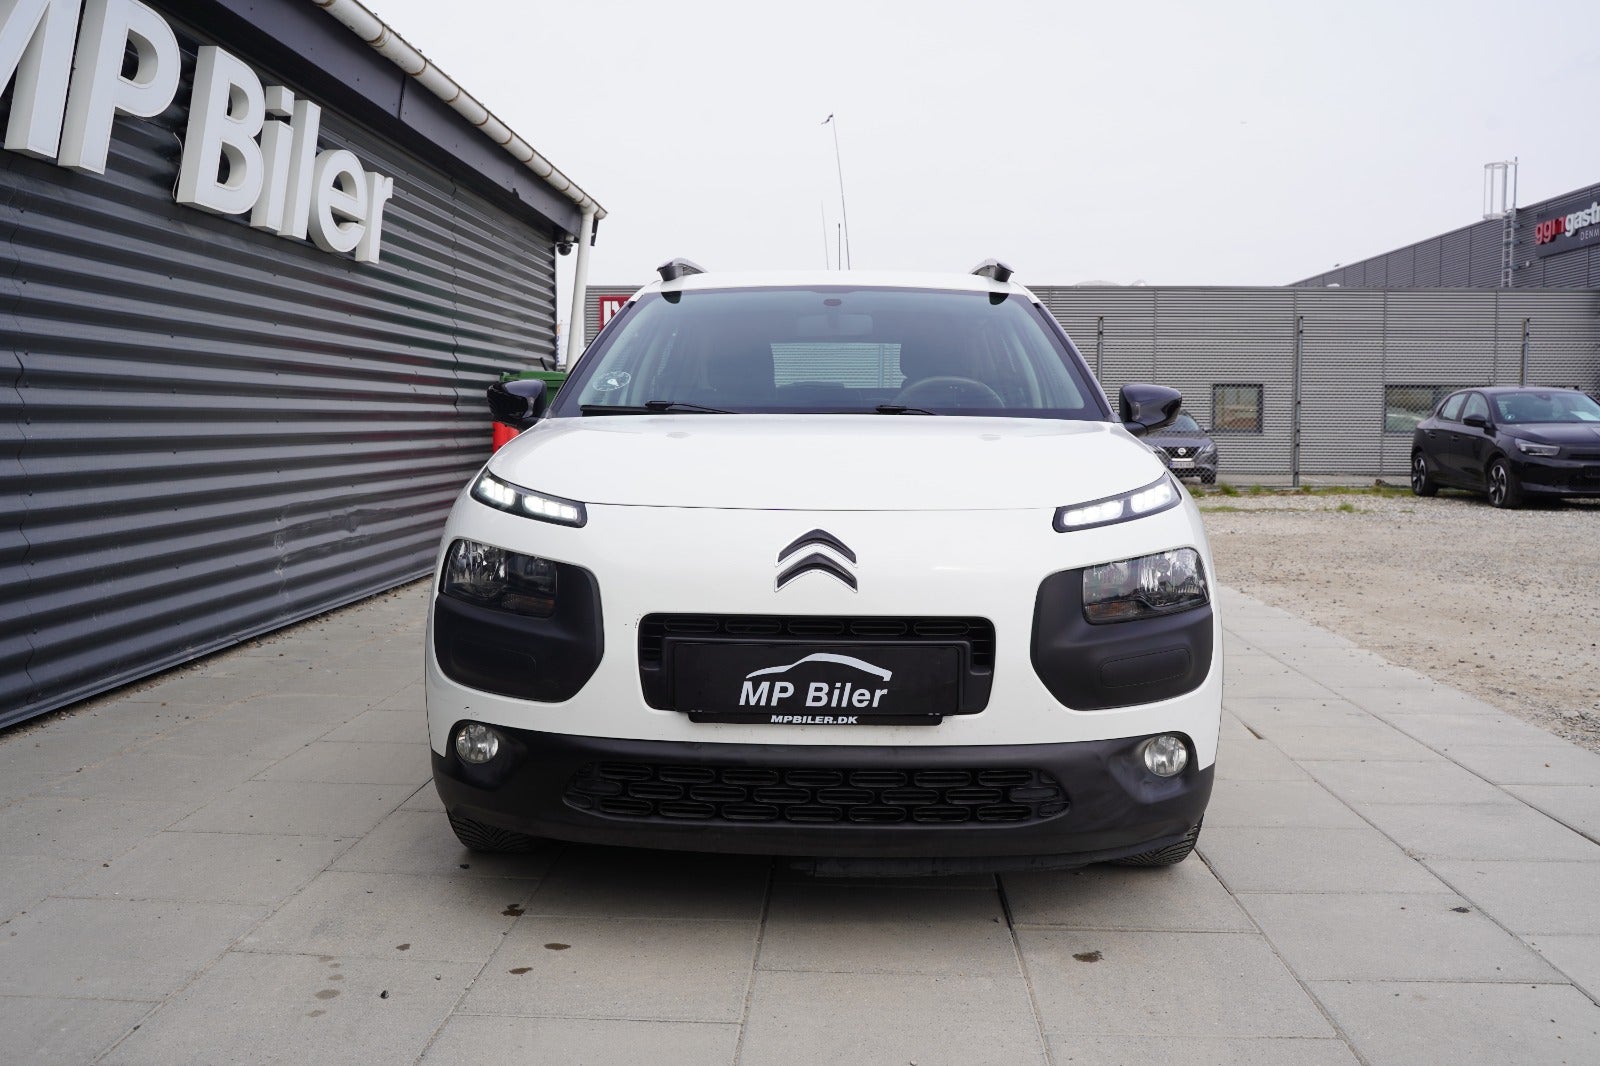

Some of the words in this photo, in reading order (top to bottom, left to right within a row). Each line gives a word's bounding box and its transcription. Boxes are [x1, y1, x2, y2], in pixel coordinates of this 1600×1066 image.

[176, 45, 394, 265] Biler
[738, 681, 794, 706] MP
[805, 682, 888, 708] Biler
[770, 715, 859, 724] MPBILER.DK
